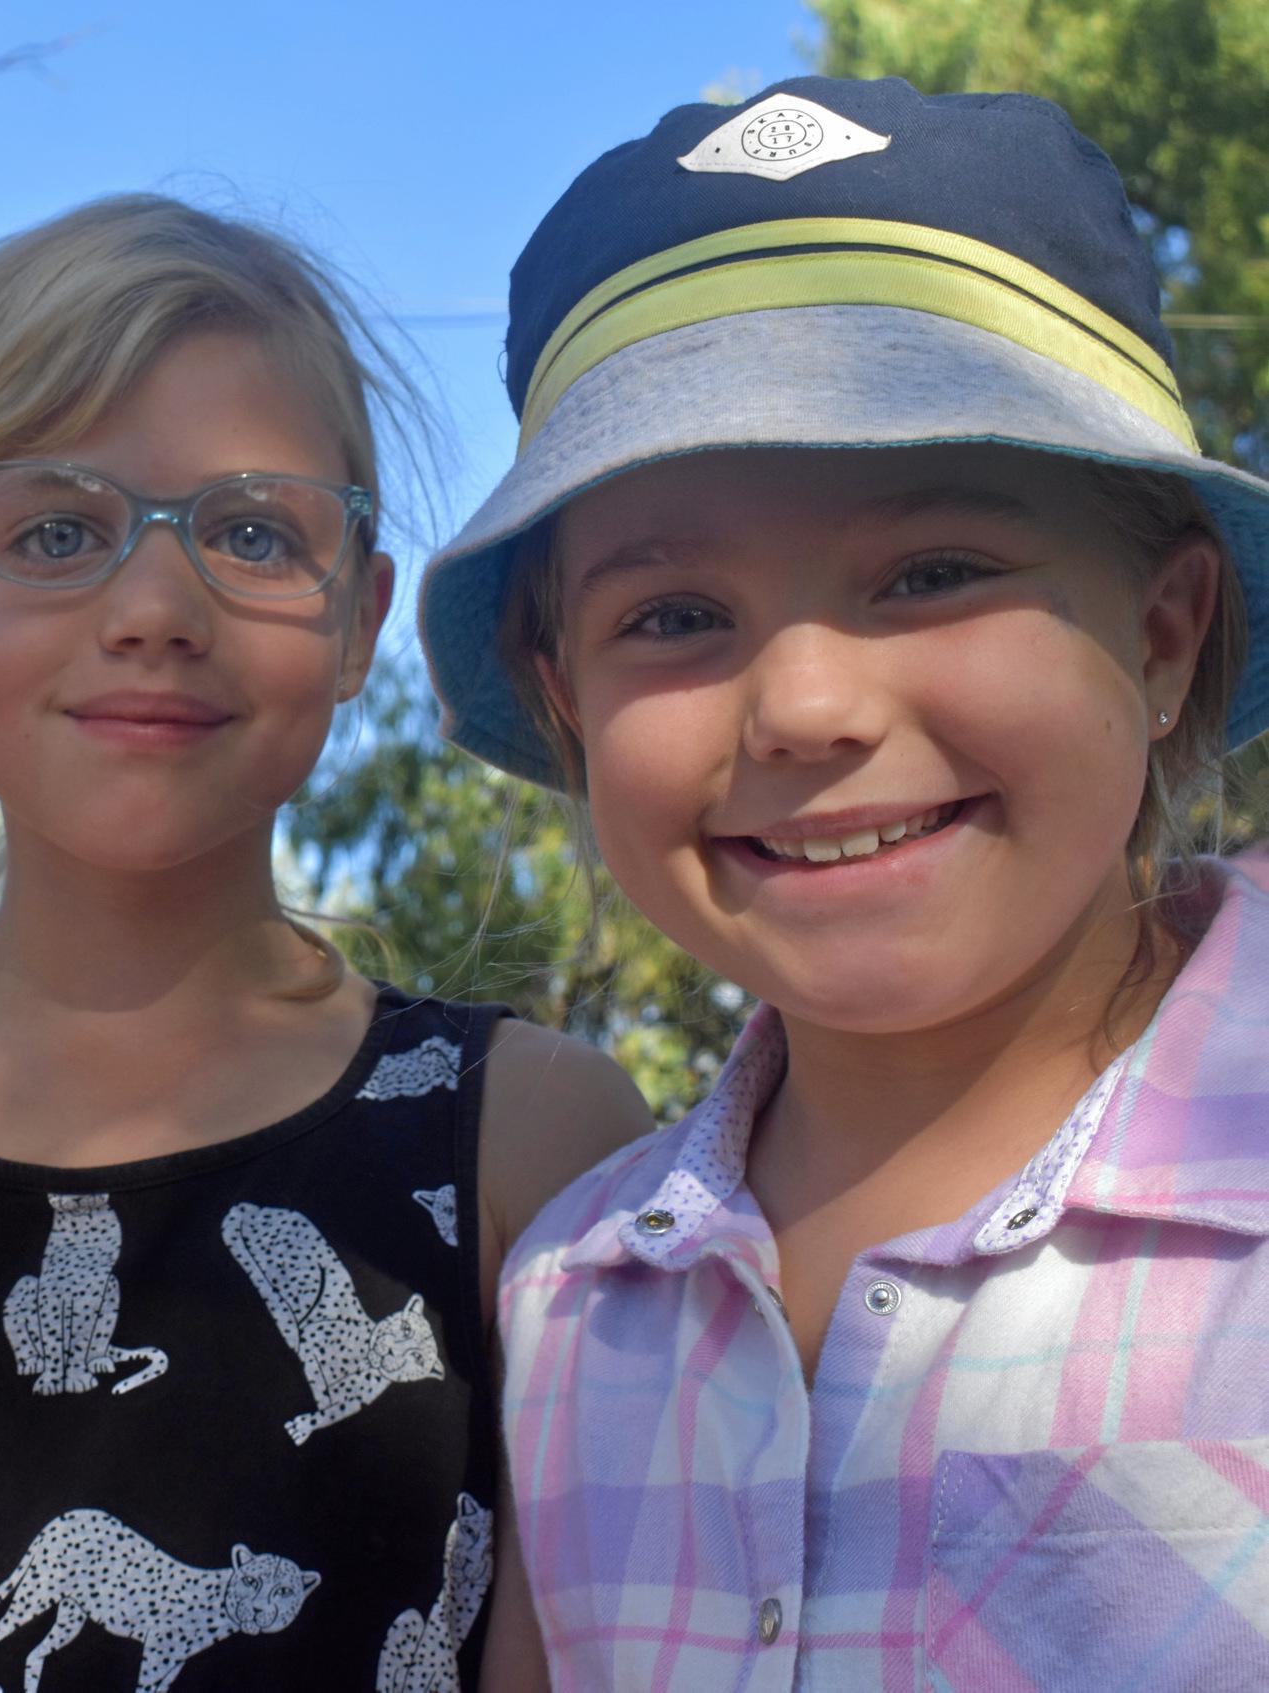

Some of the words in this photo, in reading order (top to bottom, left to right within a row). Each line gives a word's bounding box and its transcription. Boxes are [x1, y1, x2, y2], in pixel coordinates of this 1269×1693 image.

[747, 112, 815, 134] SKATE
[772, 135, 792, 144] 17
[752, 142, 812, 158] SURF
